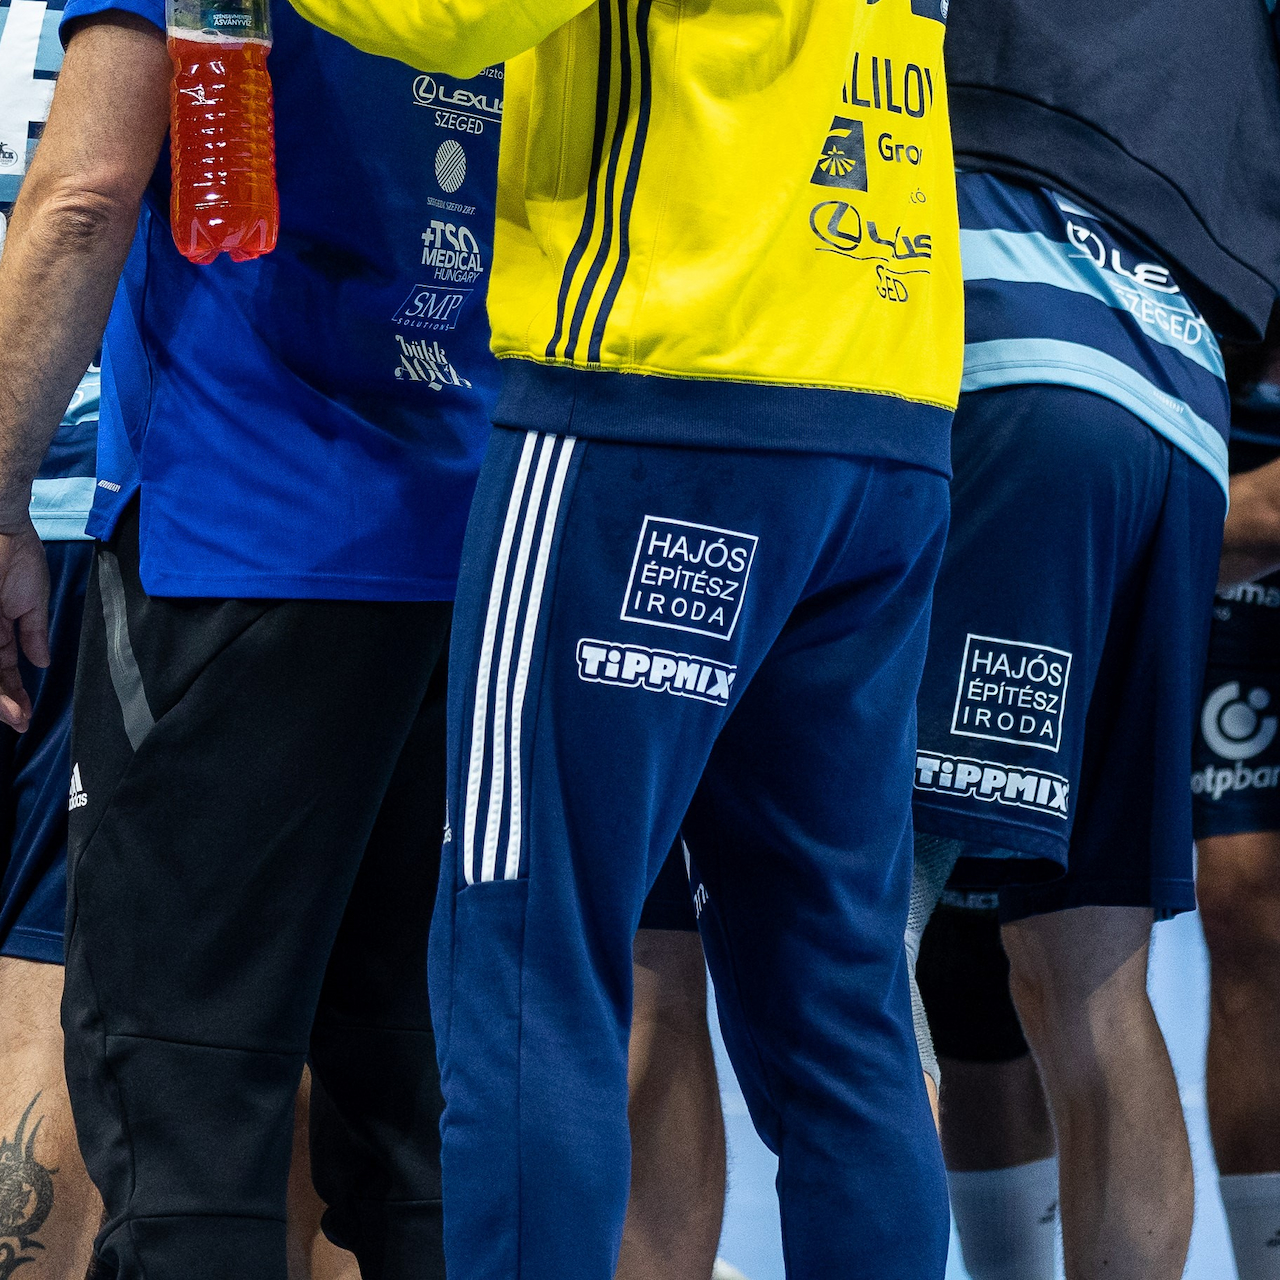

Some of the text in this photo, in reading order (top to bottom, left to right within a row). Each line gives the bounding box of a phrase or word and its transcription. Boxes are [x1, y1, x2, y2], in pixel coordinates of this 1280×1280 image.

[434, 111, 483, 135] SZEGED
[421, 246, 484, 272] MEDICAL
[433, 268, 480, 284] HUNGARY
[405, 291, 463, 321] SMP
[1115, 287, 1202, 345] SZEGED
[397, 317, 450, 331] SOLUTIONS
[648, 530, 747, 573] HAJÓS
[641, 560, 739, 601] ÉPÍTÉSZ
[634, 590, 724, 626] IRODA
[972, 649, 1063, 687] HAJÓS
[967, 677, 1059, 714] ÉPÍTÉSZ
[963, 706, 1054, 739] IRODA
